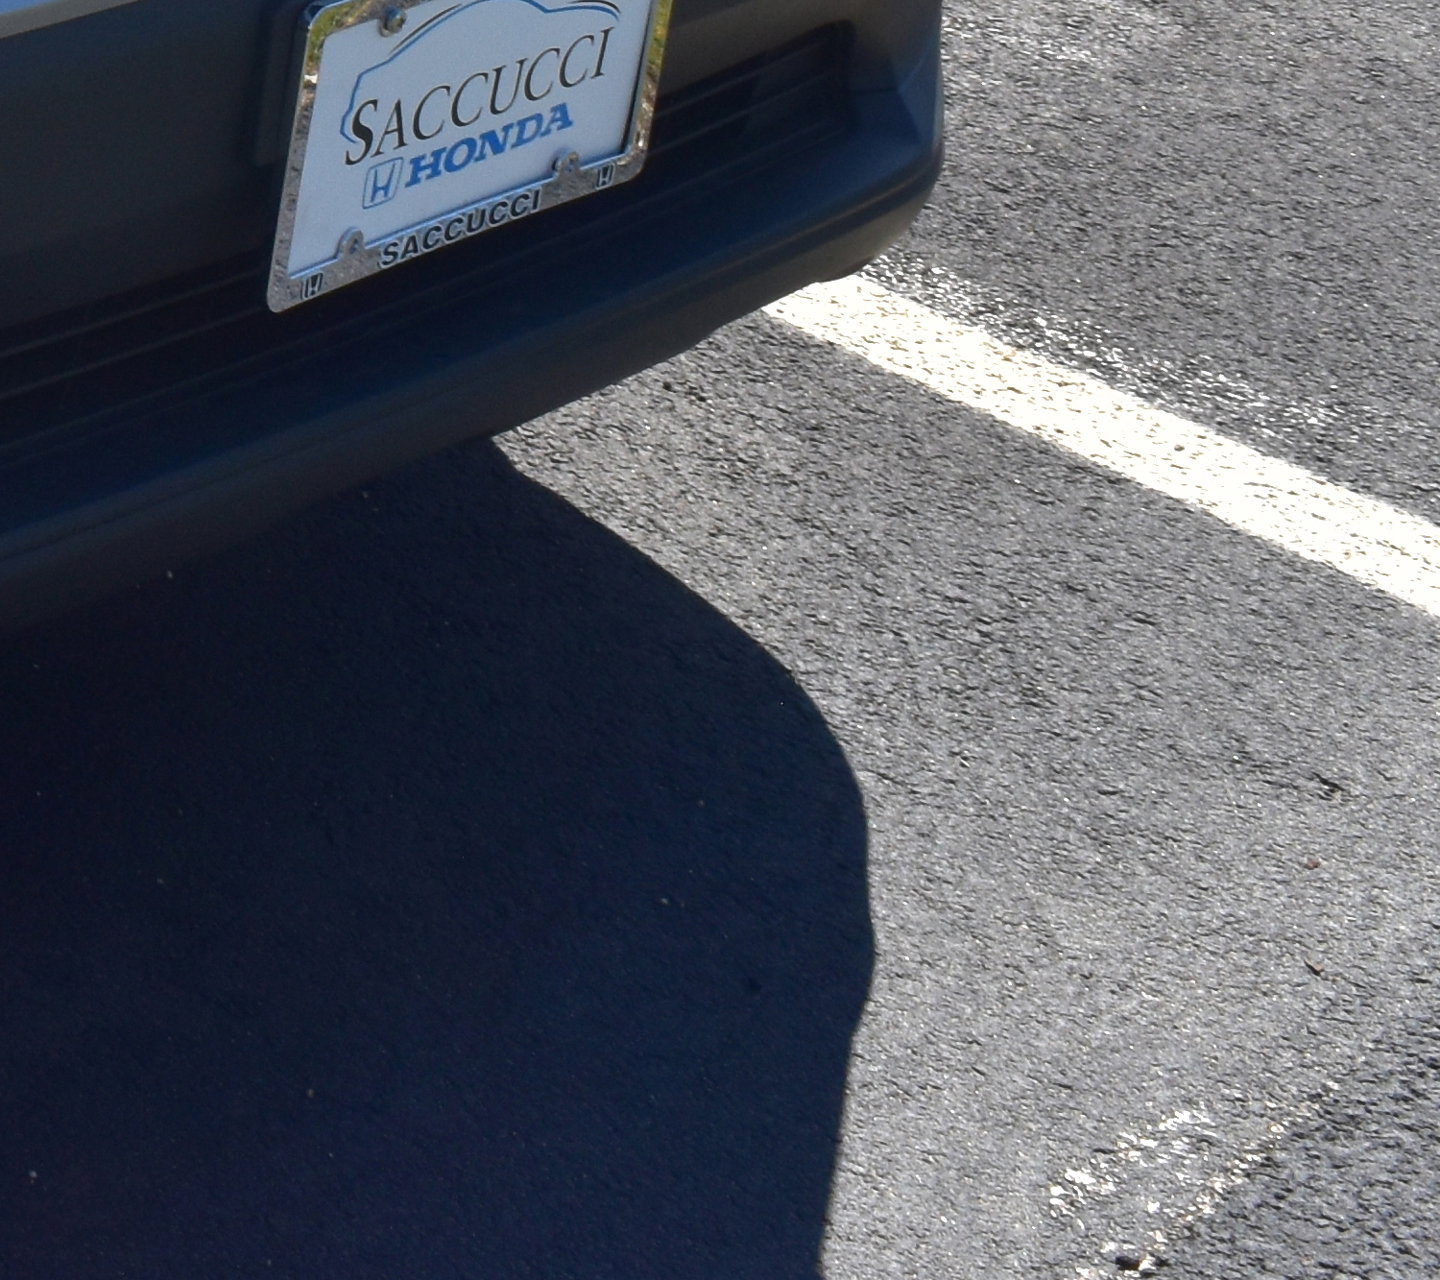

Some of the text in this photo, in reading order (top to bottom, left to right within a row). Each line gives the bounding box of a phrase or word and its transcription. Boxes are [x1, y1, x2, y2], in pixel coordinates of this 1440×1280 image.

[344, 26, 615, 166] SACCUCCI
[404, 102, 573, 188] HONDA
[381, 189, 541, 266] SACCUCCI
